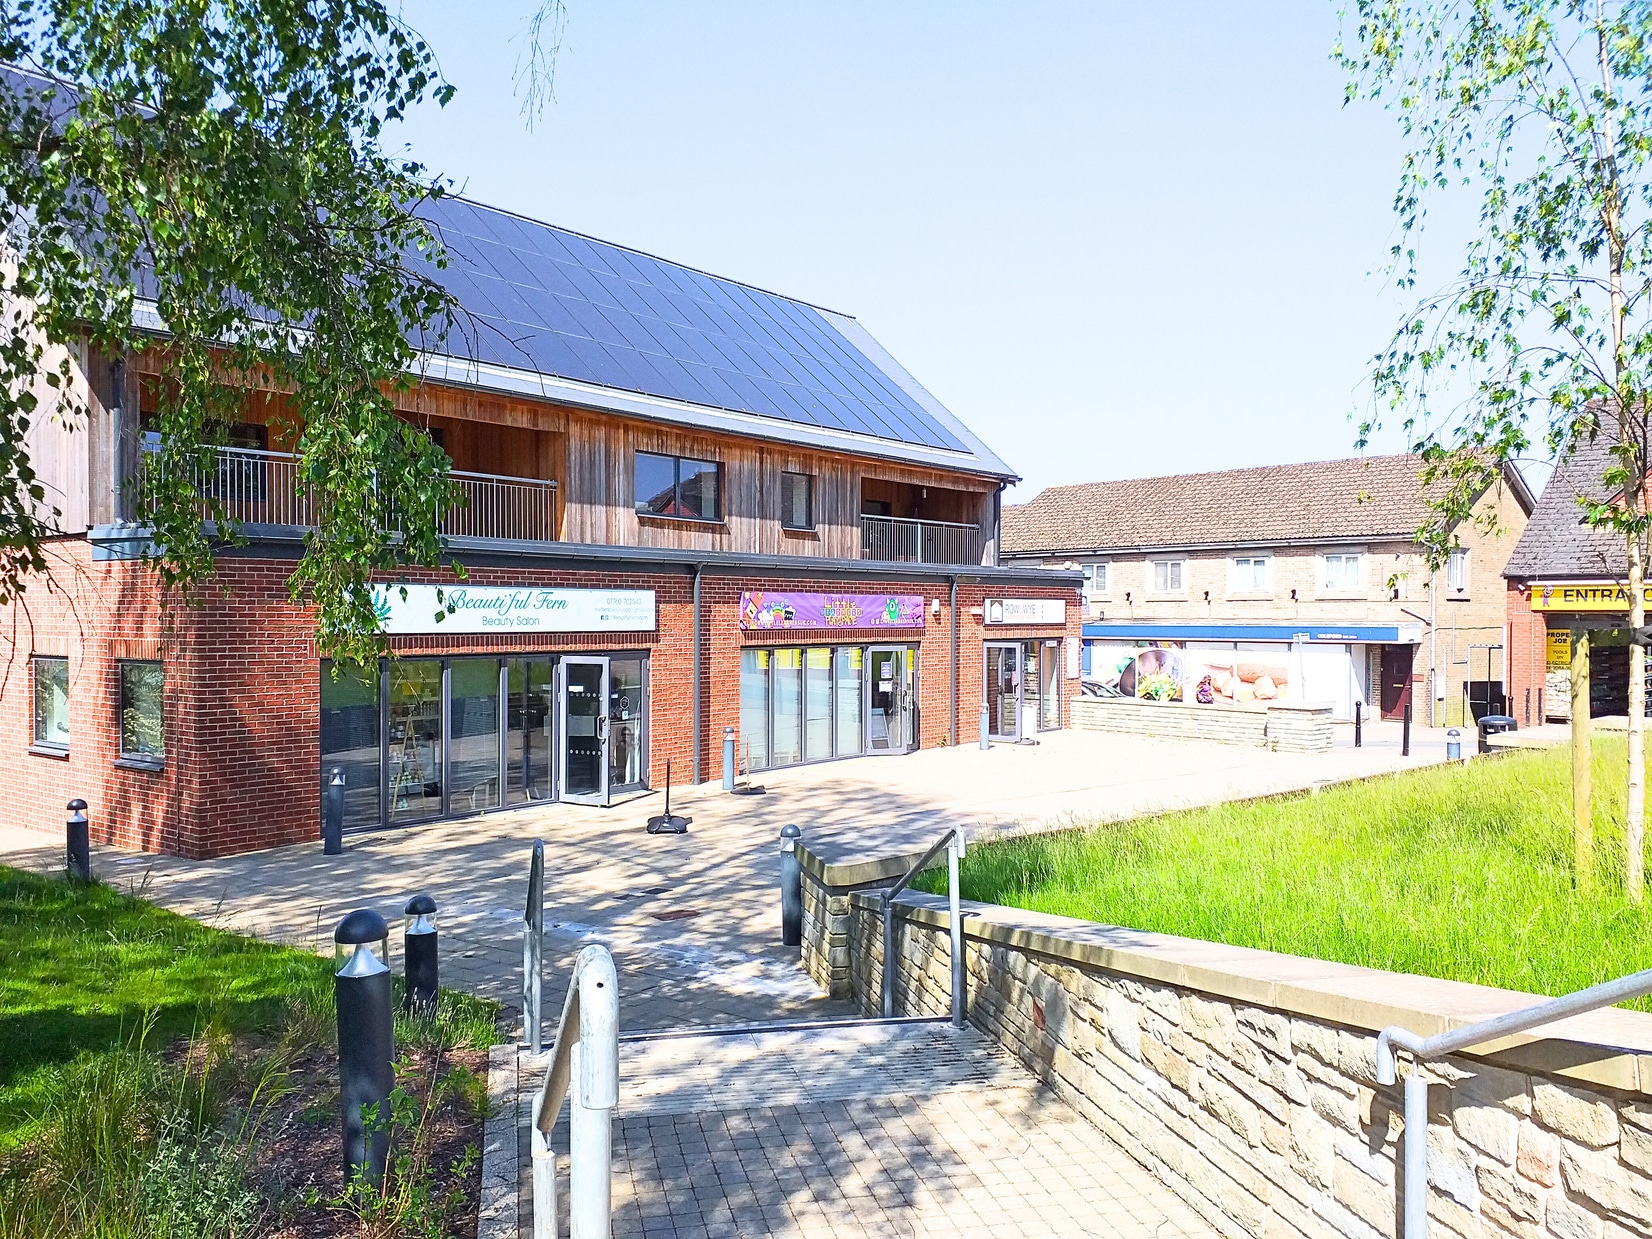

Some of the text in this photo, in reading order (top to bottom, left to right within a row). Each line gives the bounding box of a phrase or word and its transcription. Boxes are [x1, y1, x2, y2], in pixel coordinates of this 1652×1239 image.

[1563, 589, 1652, 602] ENTRAC
[450, 589, 569, 615] Beautiful Fern
[824, 596, 857, 608] Little
[482, 616, 540, 626] Beauty Salon
